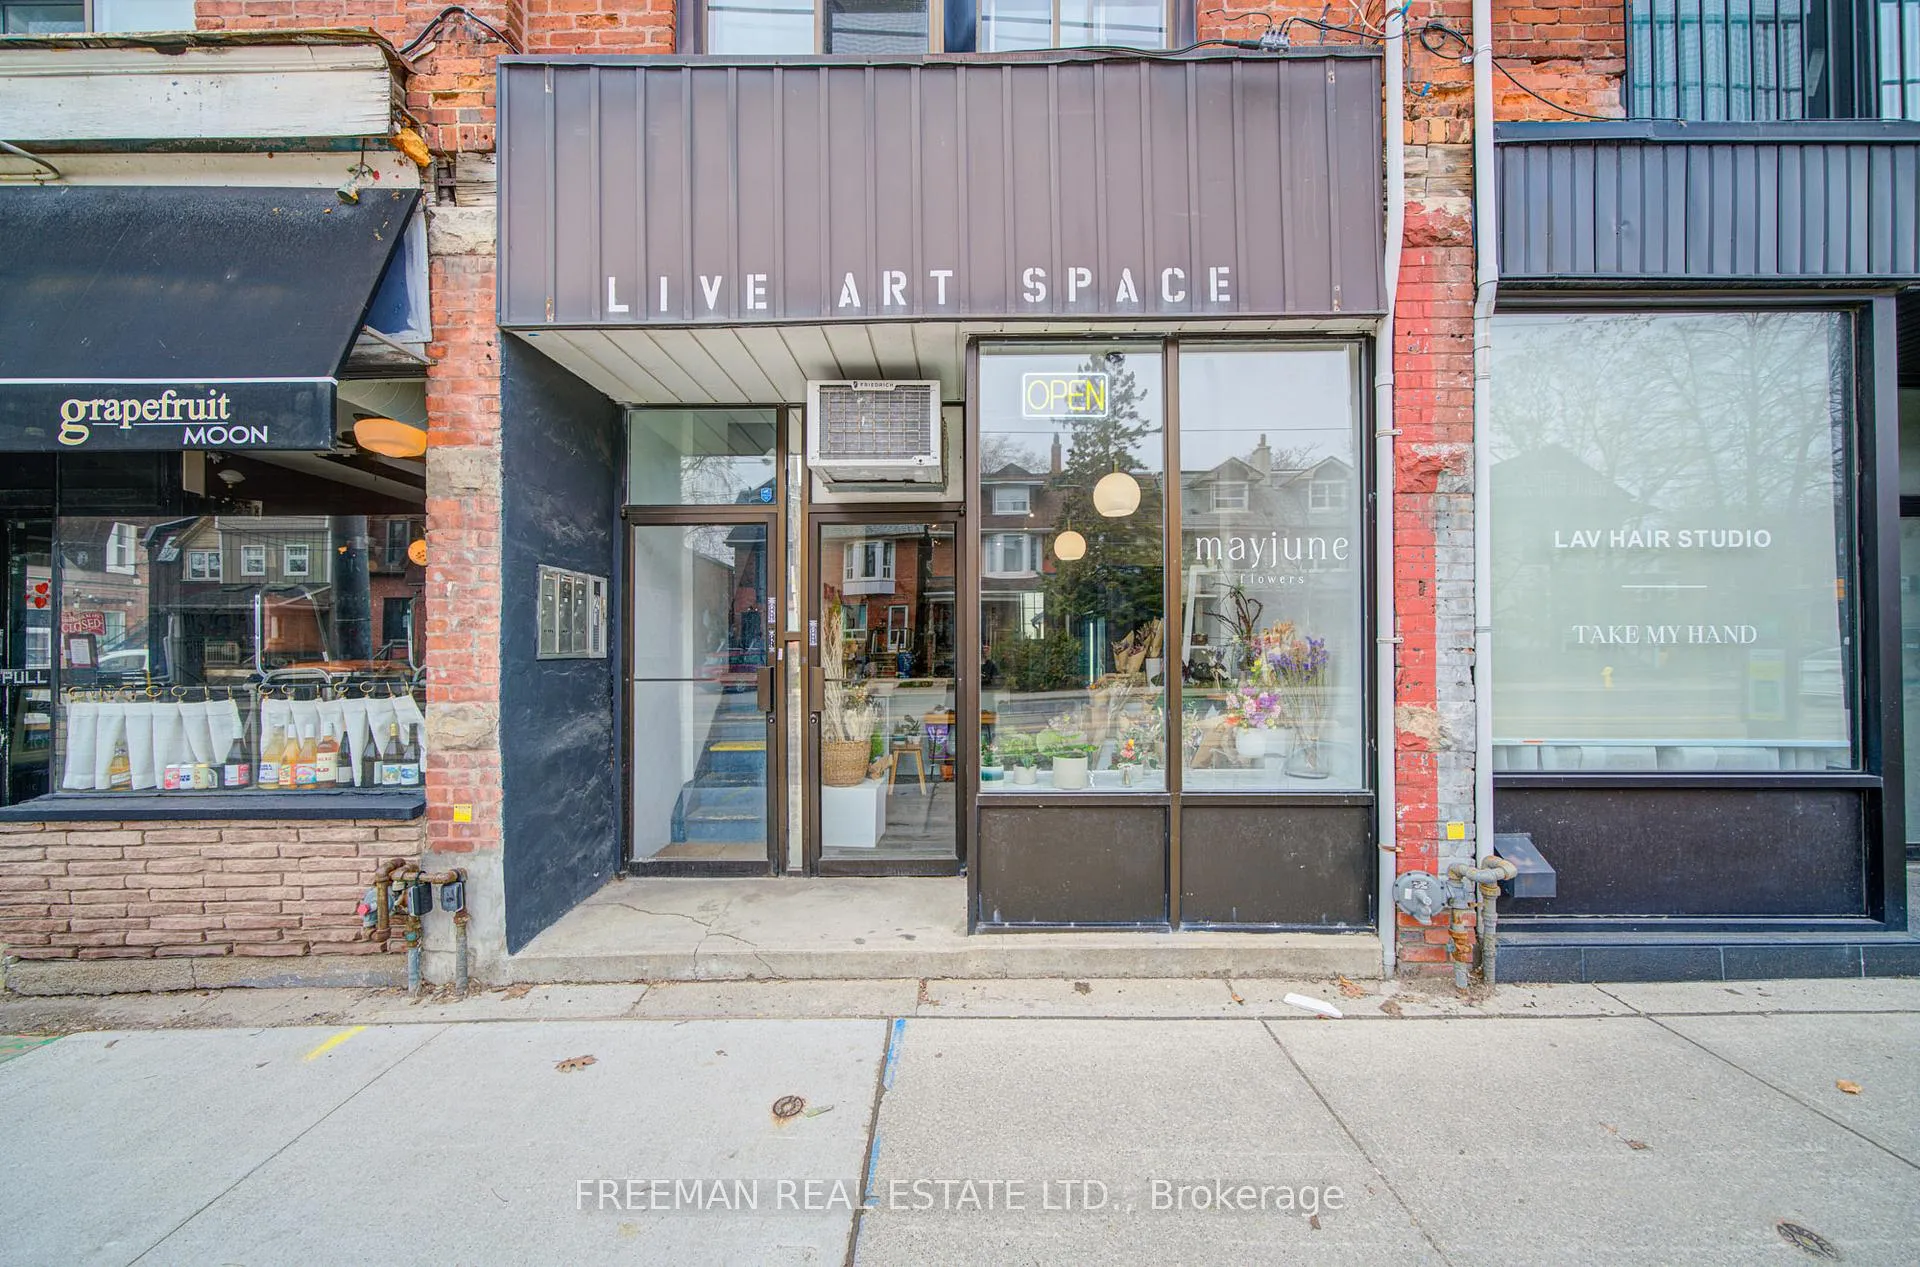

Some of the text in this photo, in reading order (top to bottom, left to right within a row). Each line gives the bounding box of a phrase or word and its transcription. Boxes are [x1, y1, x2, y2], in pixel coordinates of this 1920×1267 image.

[608, 266, 1231, 313] LIVE ART SPACE
[1027, 379, 1105, 411] OPEN
[58, 389, 231, 446] grapefruit
[183, 425, 269, 445] MOON
[1554, 529, 1772, 548] LAV HAIR STUDIO
[1196, 531, 1349, 569] mayjune
[1240, 573, 1305, 584] flowers
[62, 618, 101, 633] CLOSED
[1572, 624, 1758, 644] TAKE MY HAND
[2, 670, 48, 683] PULL
